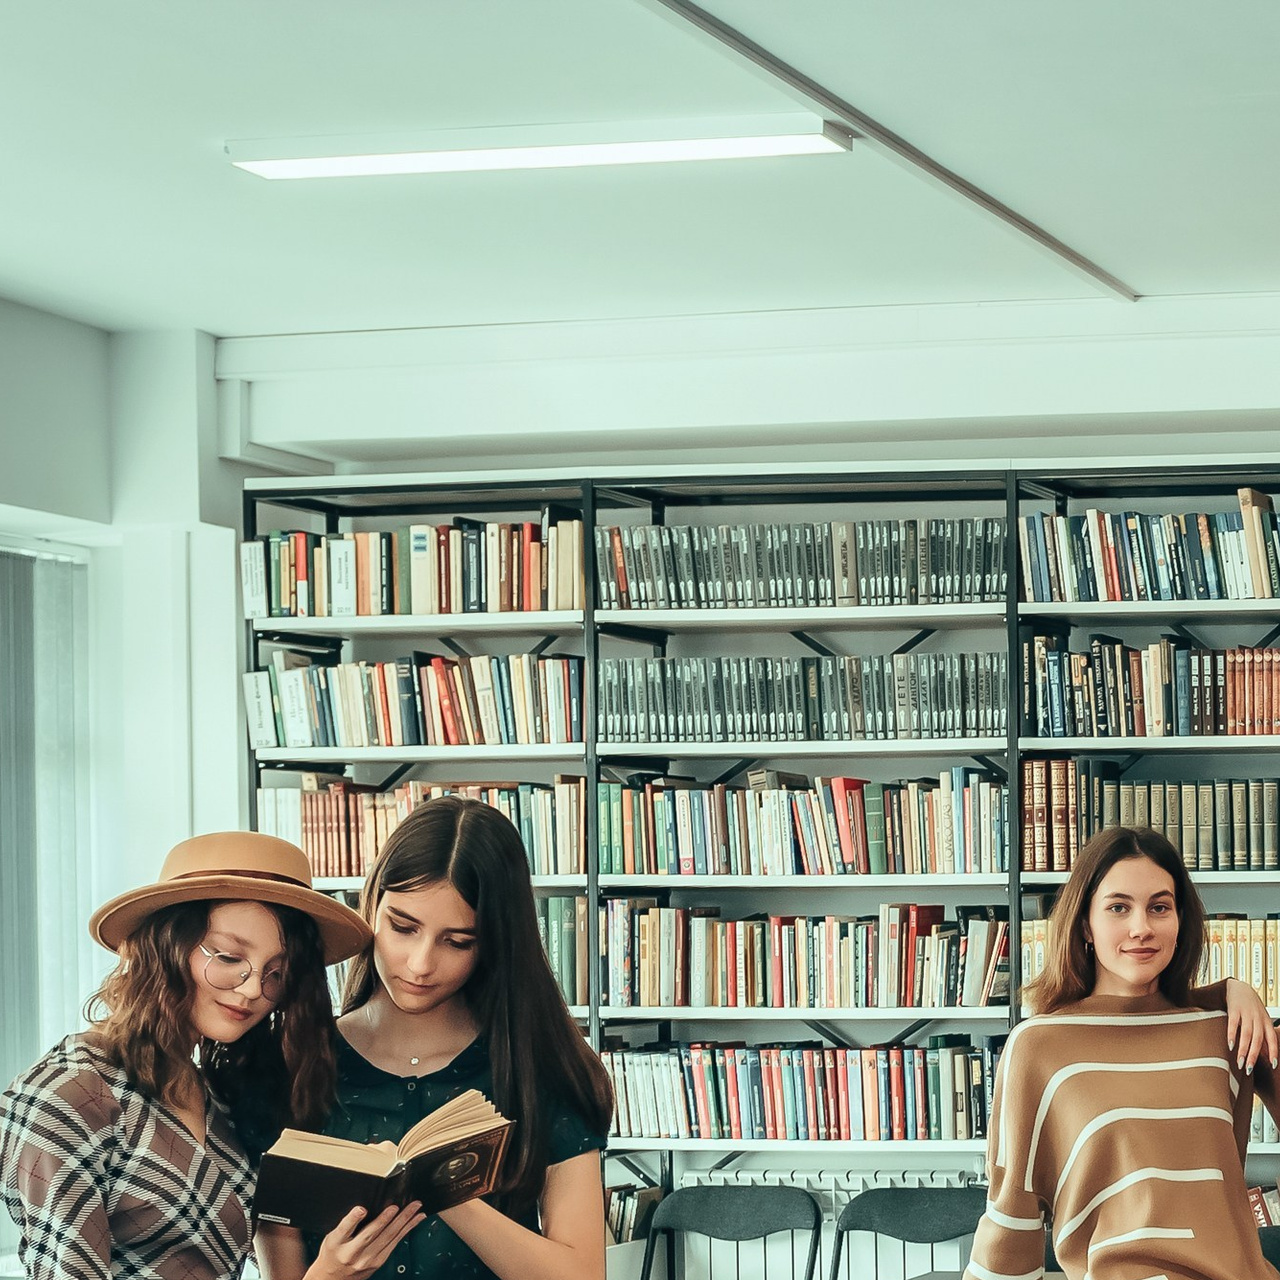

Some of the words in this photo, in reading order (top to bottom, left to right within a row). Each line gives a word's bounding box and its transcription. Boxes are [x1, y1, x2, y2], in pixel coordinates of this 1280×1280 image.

[1266, 541, 1278, 588] СТАТИСТИКА
[898, 676, 906, 706] ГЕТЕ
[943, 804, 952, 862] ГОМЕОСТАЗ
